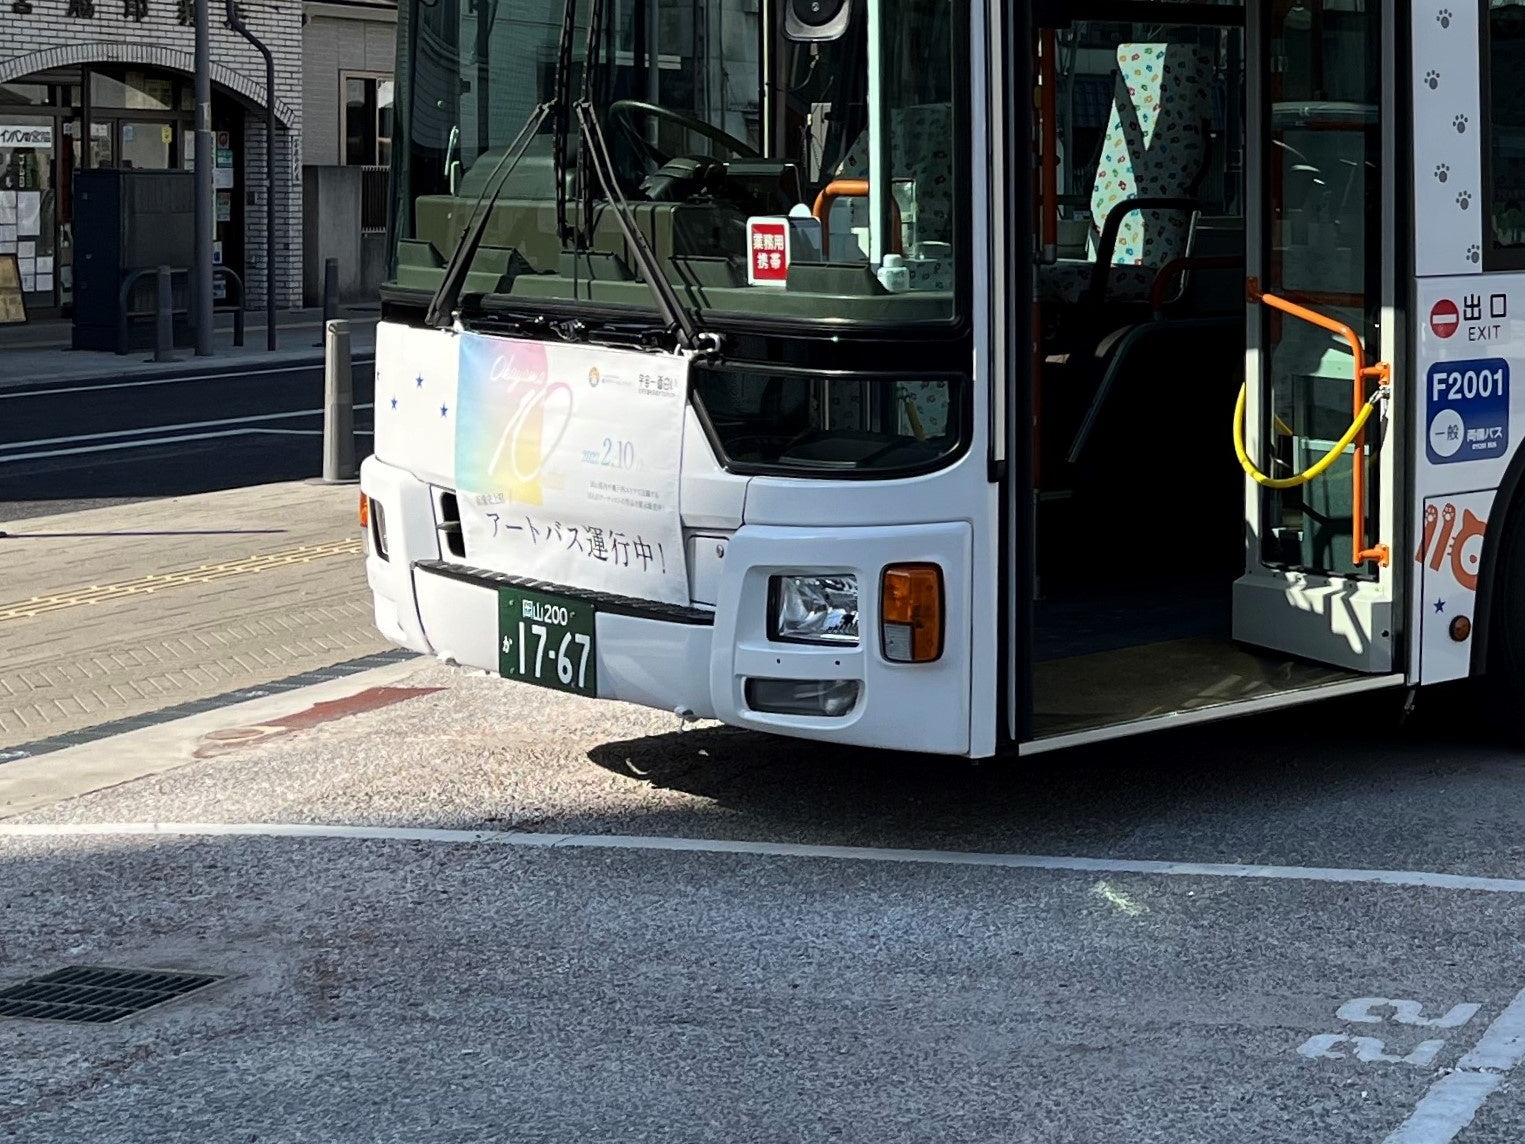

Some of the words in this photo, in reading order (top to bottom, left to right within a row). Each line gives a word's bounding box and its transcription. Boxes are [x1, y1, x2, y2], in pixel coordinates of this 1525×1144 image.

[753, 233, 784, 251] 業務用
[1463, 294, 1507, 321] 出口
[1468, 325, 1501, 341] EXIT
[1432, 369, 1503, 401] F2001
[1435, 423, 1459, 441] 一般
[1466, 426, 1503, 442] 両備バス
[486, 512, 666, 573] アートバス運行中!
[519, 622, 591, 688] 17-67
